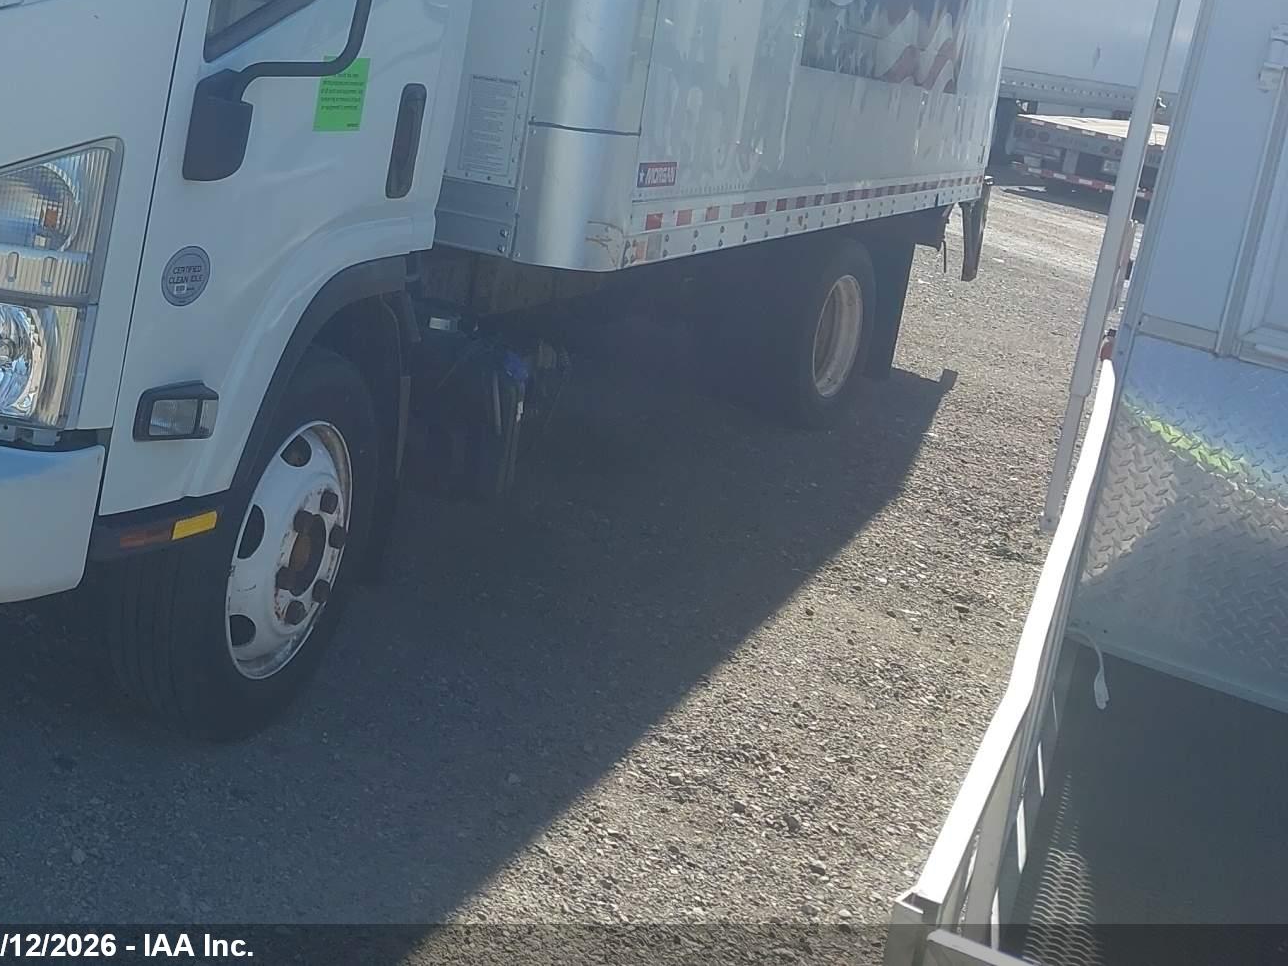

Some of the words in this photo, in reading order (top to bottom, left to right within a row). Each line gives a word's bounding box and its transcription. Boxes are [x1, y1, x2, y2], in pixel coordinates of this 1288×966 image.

[645, 167, 675, 184] MORGAN
[173, 266, 202, 274] CERTIFIED
[169, 276, 188, 284] CLEAN
